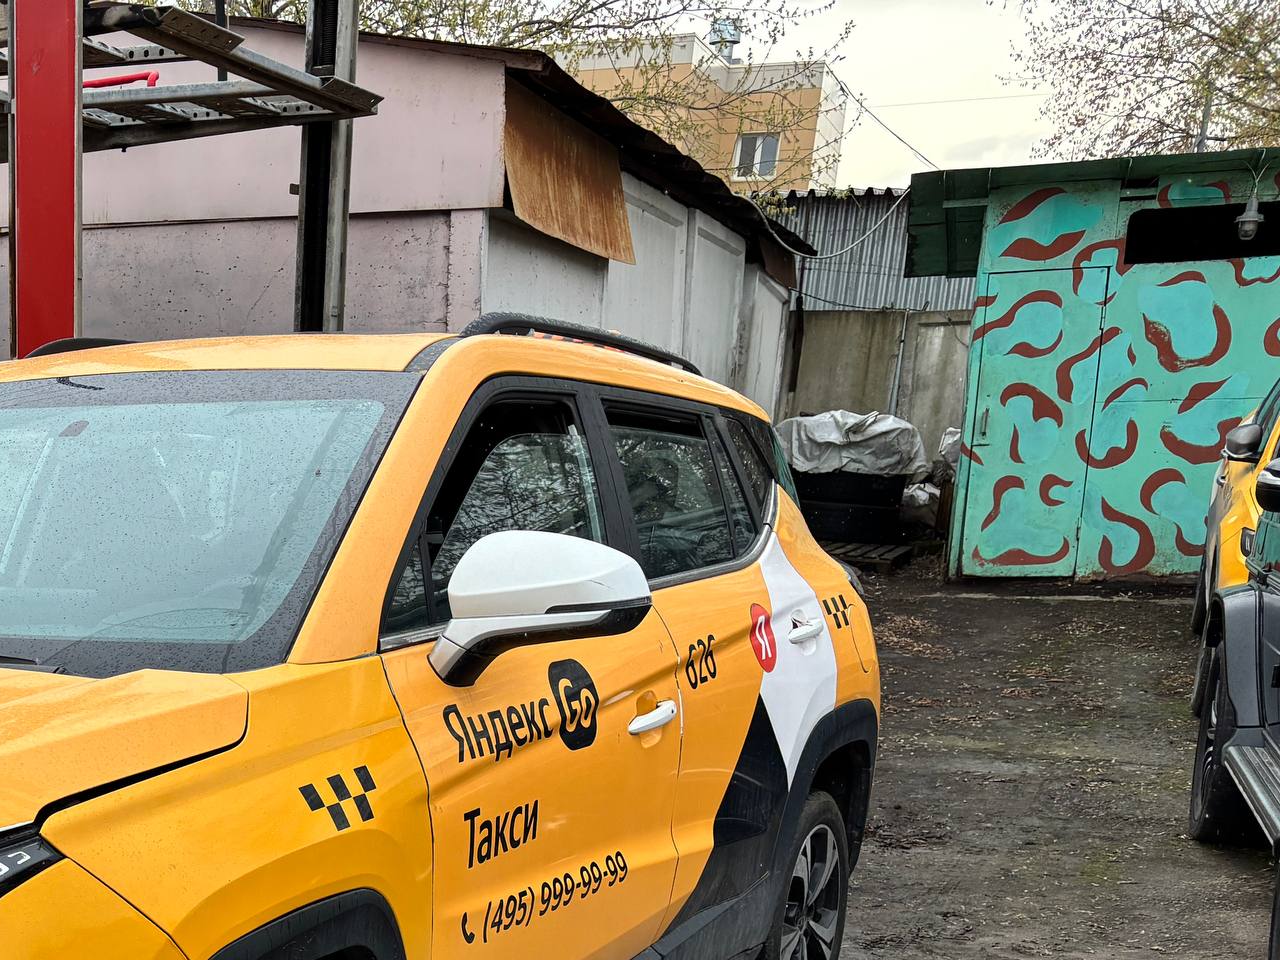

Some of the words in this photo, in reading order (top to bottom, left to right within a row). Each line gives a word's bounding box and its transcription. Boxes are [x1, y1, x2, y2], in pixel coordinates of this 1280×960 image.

[685, 634, 717, 690] 626
[755, 614, 773, 661] Я
[442, 697, 554, 763] Яндекс
[558, 677, 596, 733] Go
[464, 799, 539, 869] Такси
[483, 886, 535, 943] (495)
[539, 851, 628, 917] 999-99-99
